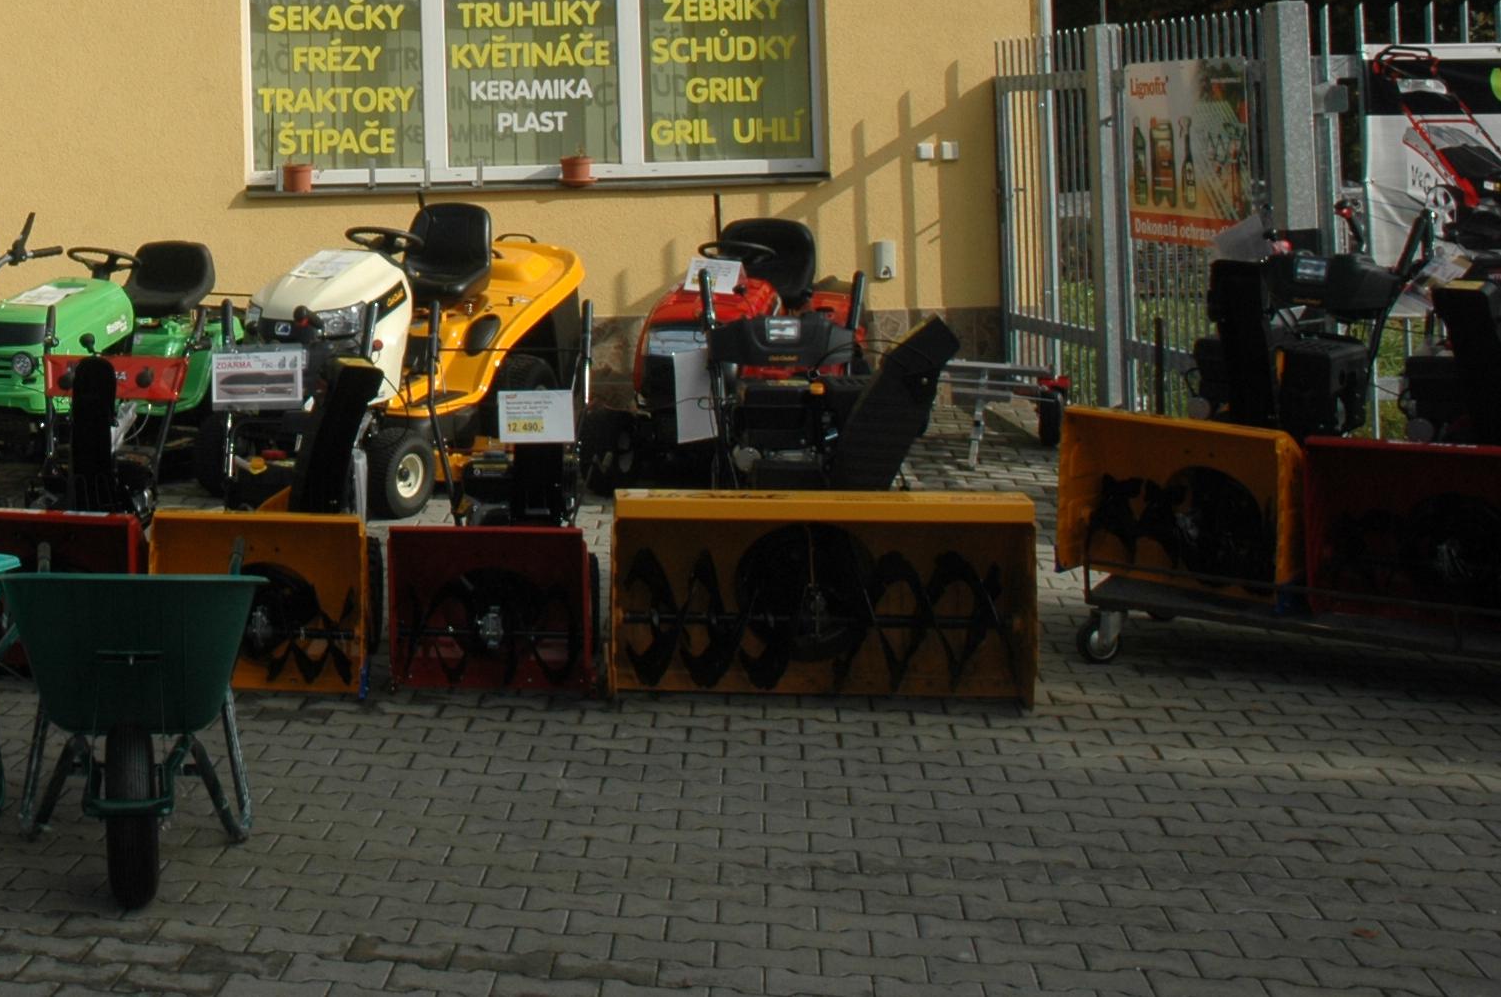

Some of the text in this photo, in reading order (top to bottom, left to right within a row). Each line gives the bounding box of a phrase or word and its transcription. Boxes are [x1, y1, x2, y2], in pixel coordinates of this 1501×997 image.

[292, 39, 382, 72] FRÉZY
[451, 33, 610, 70] KVĚTINÁČE
[651, 28, 797, 66] SCHŮDKY
[258, 86, 414, 115] TRAKTORY
[470, 77, 594, 103] KERAMIKA
[685, 76, 764, 105] GRILY
[1130, 75, 1166, 100] Lignofix
[497, 110, 568, 134] PLAST
[650, 110, 805, 146] GRIL UHLÍ
[277, 121, 396, 156] ŠTÍPAČE
[1134, 217, 1178, 237] Dokonalá
[216, 362, 252, 370] ZDARMA
[508, 423, 517, 432] 12
